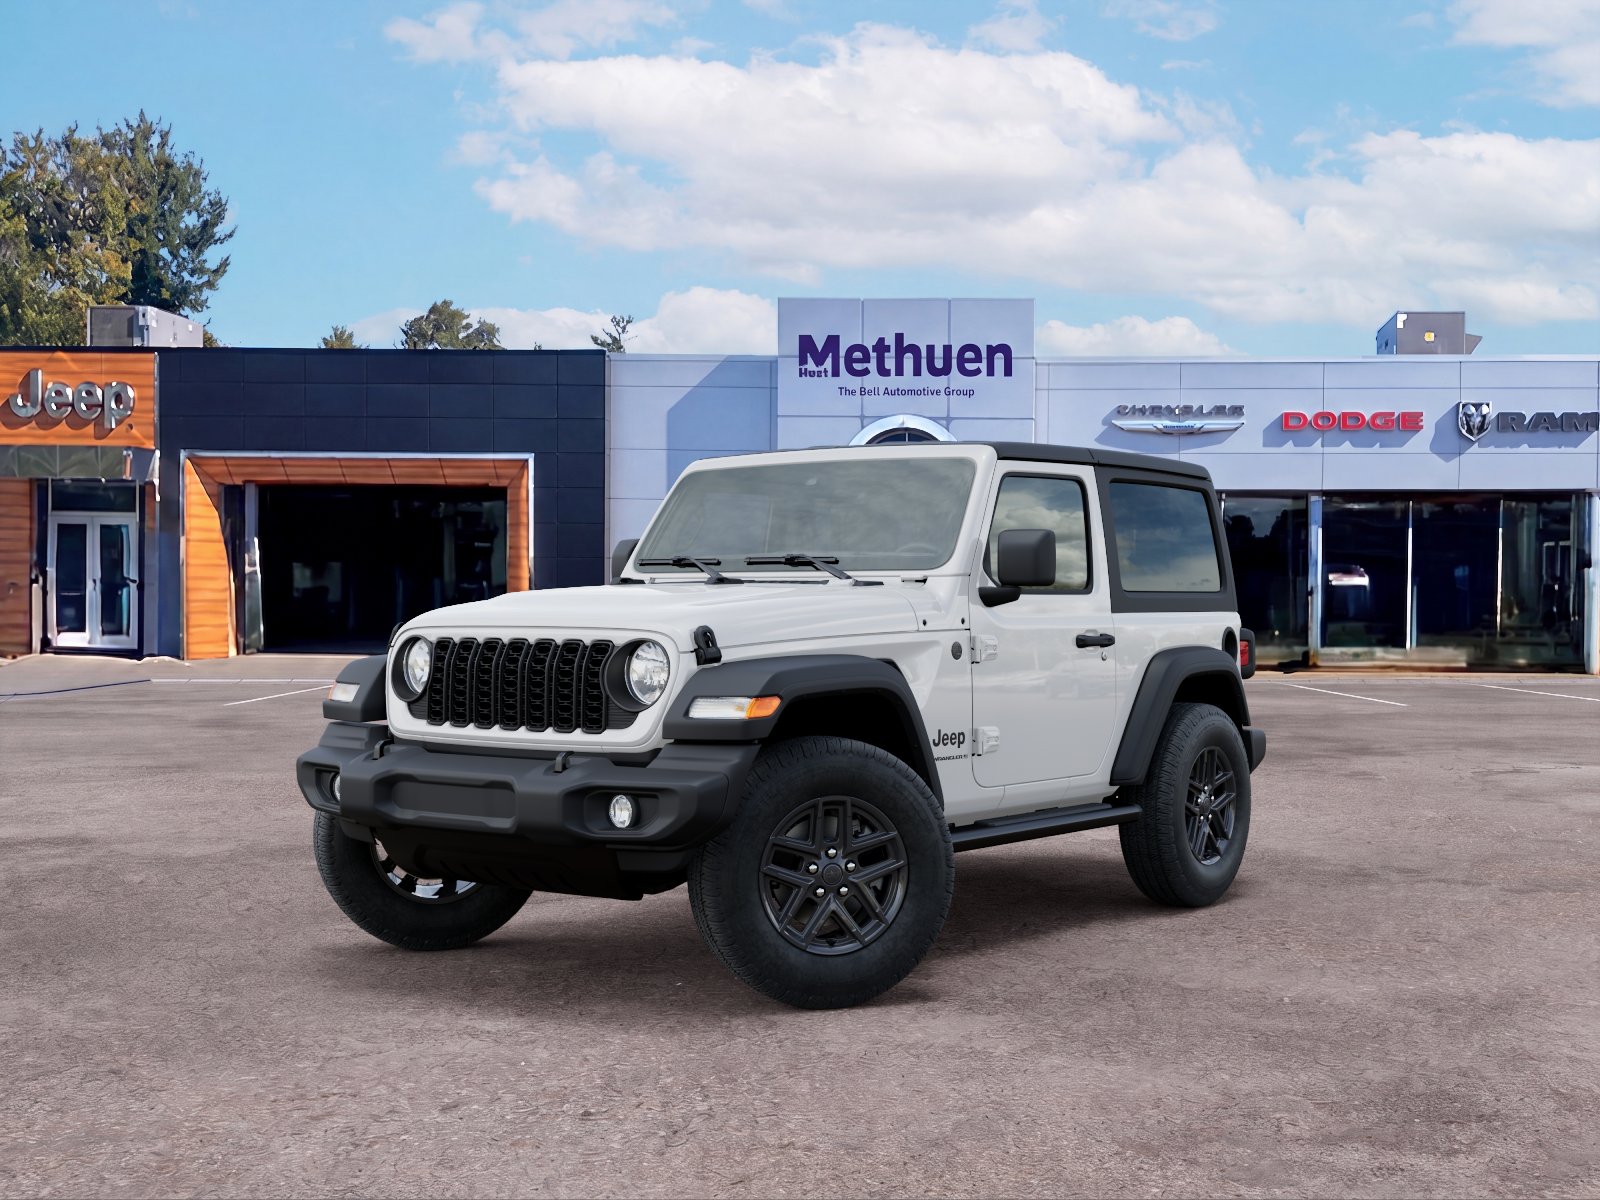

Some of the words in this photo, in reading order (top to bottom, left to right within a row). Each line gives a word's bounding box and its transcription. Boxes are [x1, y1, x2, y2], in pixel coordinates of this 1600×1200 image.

[798, 332, 1013, 377] Methuen
[9, 368, 136, 429] Jeep
[838, 386, 857, 396] The
[860, 386, 880, 396] Bell
[883, 386, 942, 396] Automotive
[944, 386, 975, 398] Group
[1282, 411, 1424, 431] DODGE
[1498, 411, 1599, 432] RAM
[932, 729, 965, 748] Jeep
